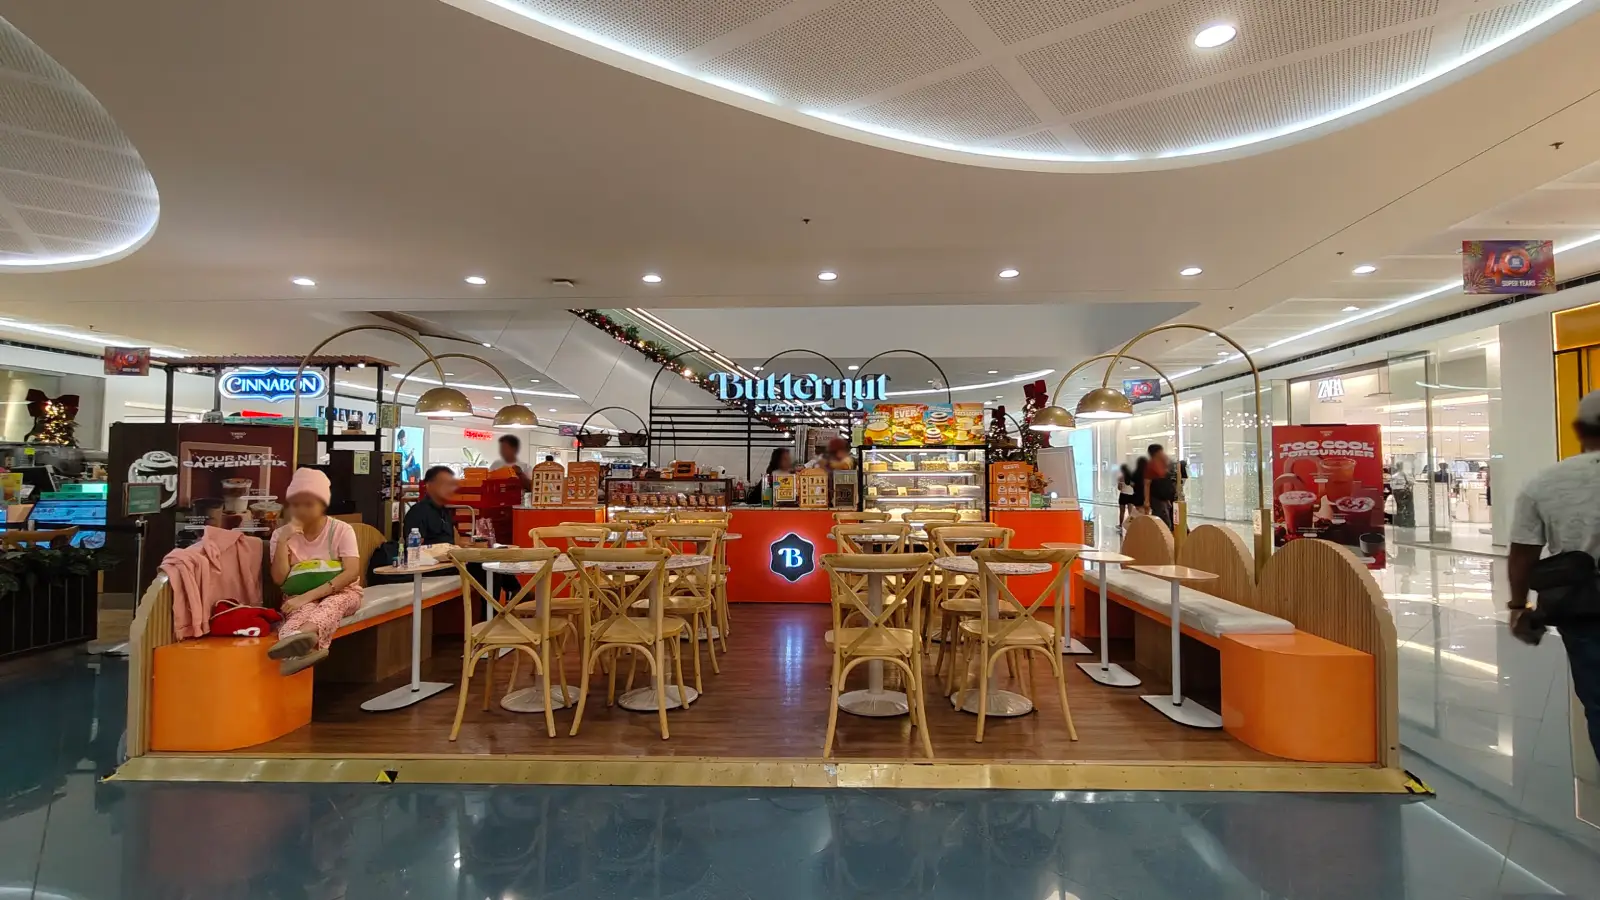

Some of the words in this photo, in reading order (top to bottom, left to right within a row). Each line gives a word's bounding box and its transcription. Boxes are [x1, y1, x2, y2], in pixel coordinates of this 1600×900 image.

[1484, 248, 1531, 285] 40
[227, 376, 317, 393] CINNABON
[709, 372, 888, 411] Butternut
[1317, 378, 1345, 399] ZARA
[765, 404, 817, 413] BAKERY
[1280, 440, 1319, 452] TOO
[1321, 440, 1374, 452] COOL
[237, 453, 274, 461] NEXT
[1280, 449, 1308, 458] FOR
[1308, 449, 1375, 458] SUMMER
[182, 460, 262, 468] CAFFEINE
[262, 459, 288, 467] FIX
[777, 547, 804, 569] B
